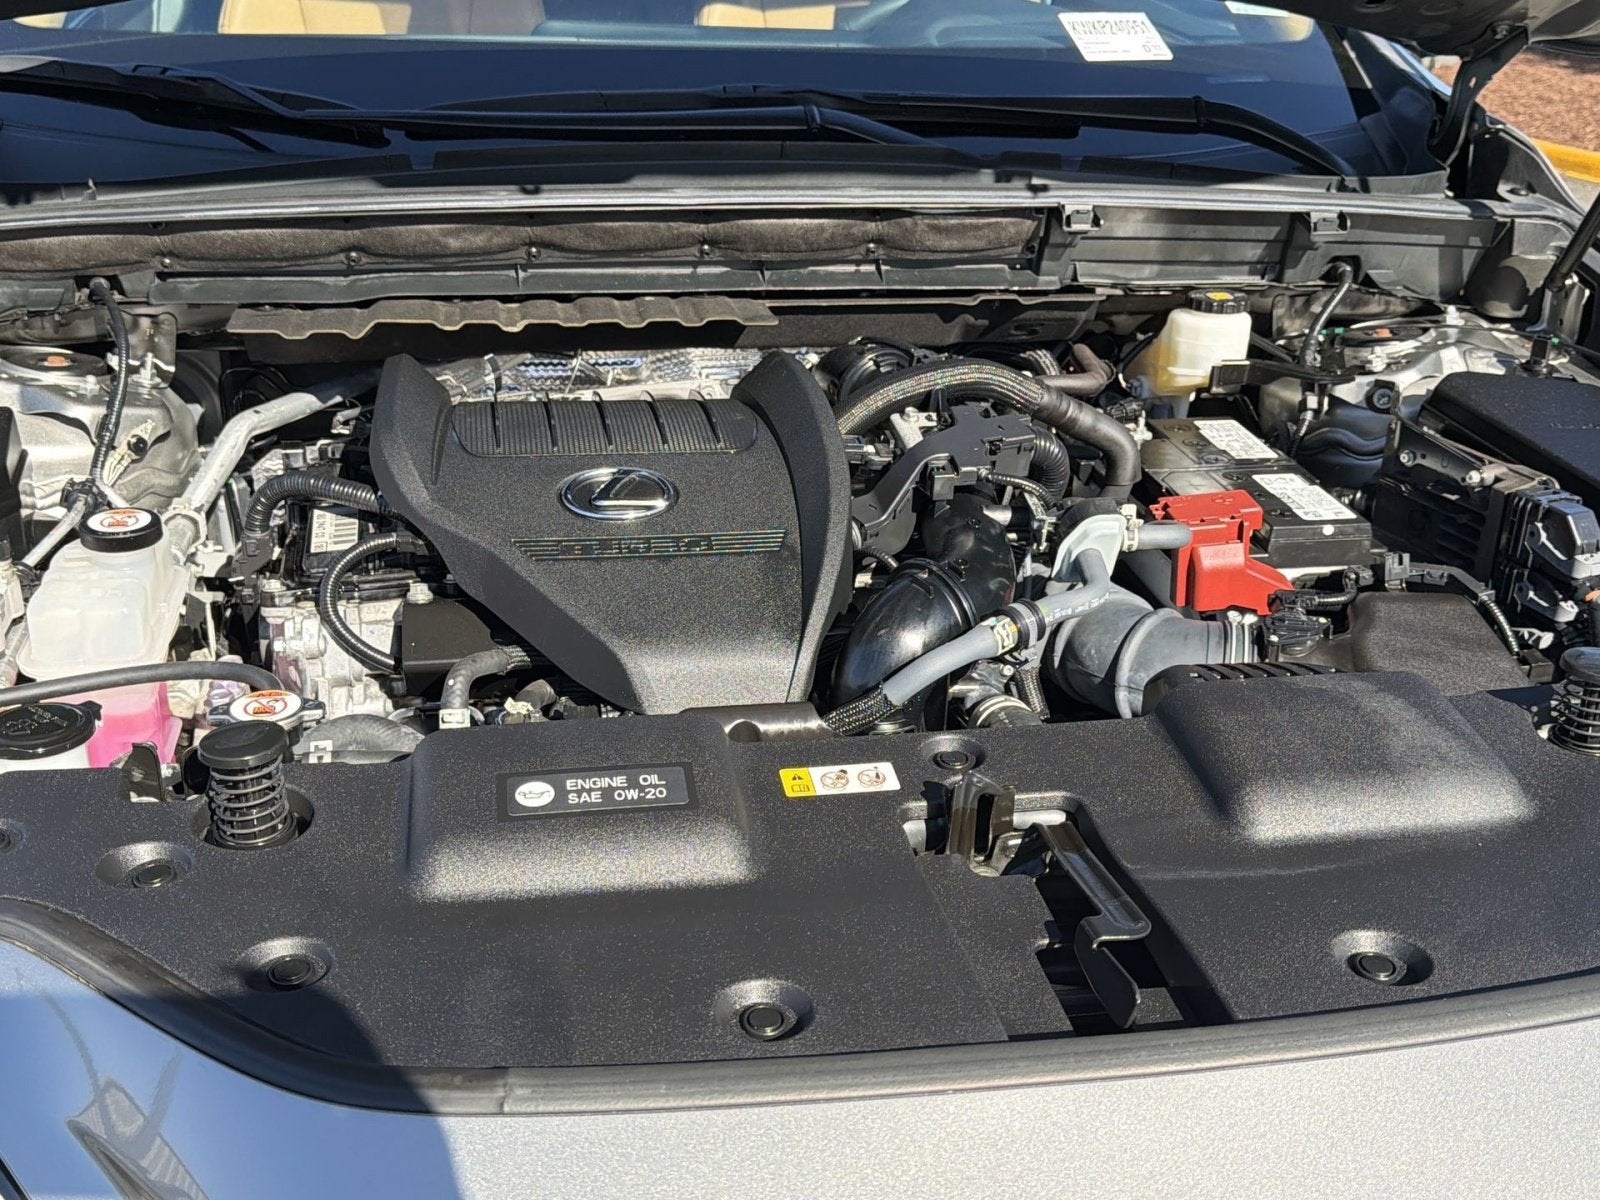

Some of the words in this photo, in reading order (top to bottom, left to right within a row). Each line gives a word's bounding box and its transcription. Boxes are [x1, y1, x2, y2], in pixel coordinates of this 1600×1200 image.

[566, 776, 629, 791] ENGINE
[639, 774, 667, 786] OIL
[568, 791, 603, 804] SAE
[613, 786, 667, 801] 0W-20
